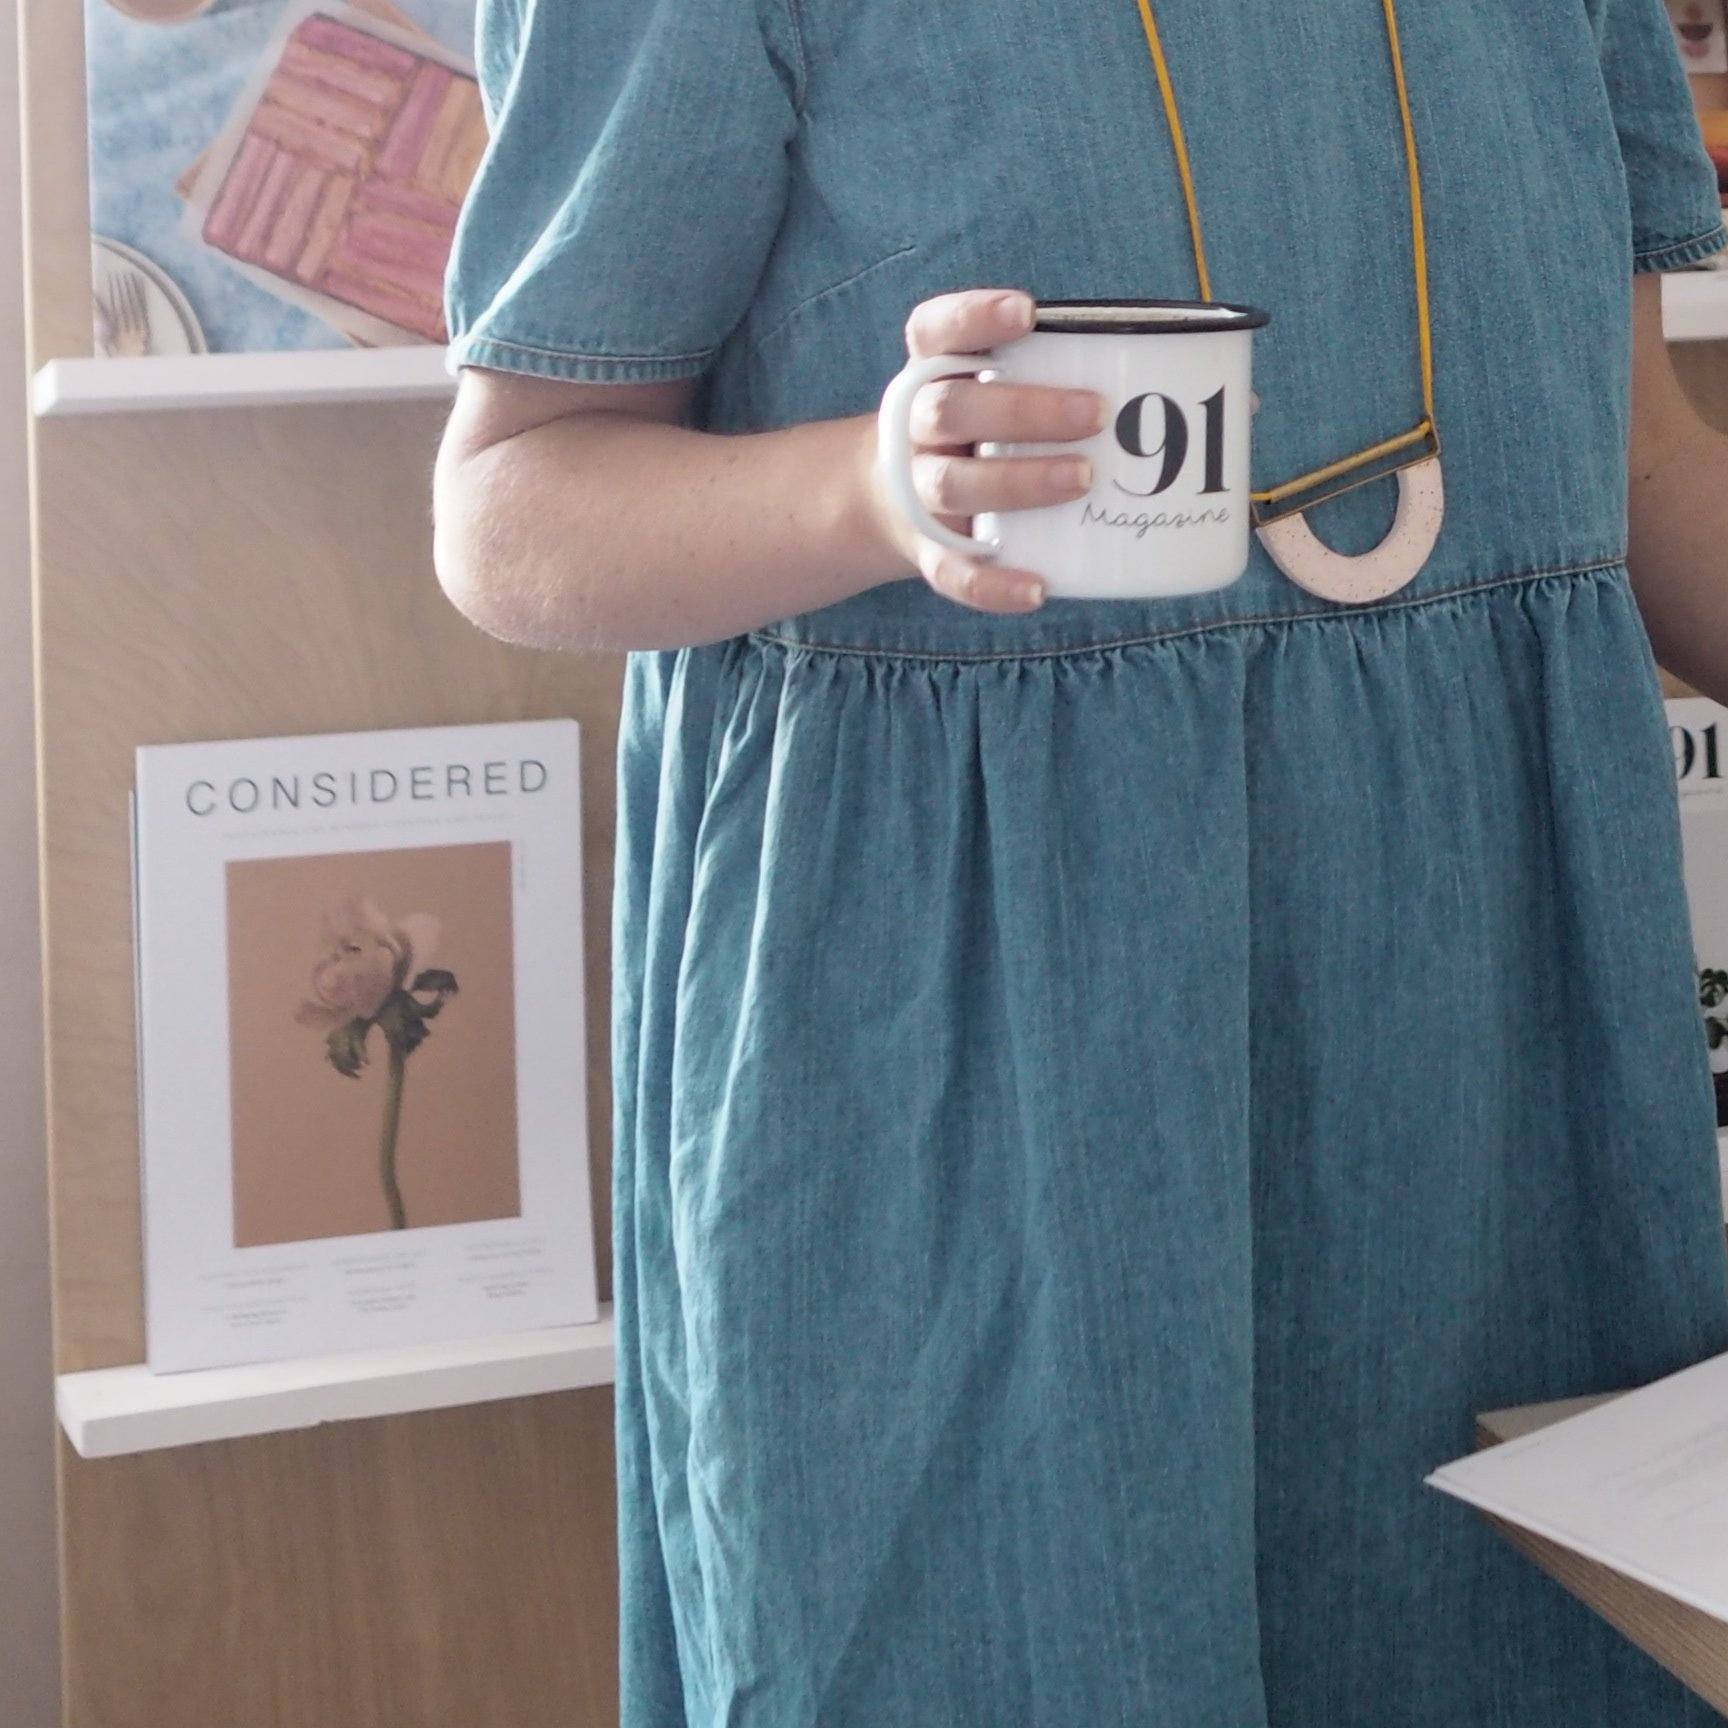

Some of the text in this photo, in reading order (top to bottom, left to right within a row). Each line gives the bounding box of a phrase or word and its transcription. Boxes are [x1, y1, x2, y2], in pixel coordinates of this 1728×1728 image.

[1112, 384, 1231, 497] 91
[1080, 502, 1231, 540] Magazine
[185, 758, 548, 817] CONSIDERED
